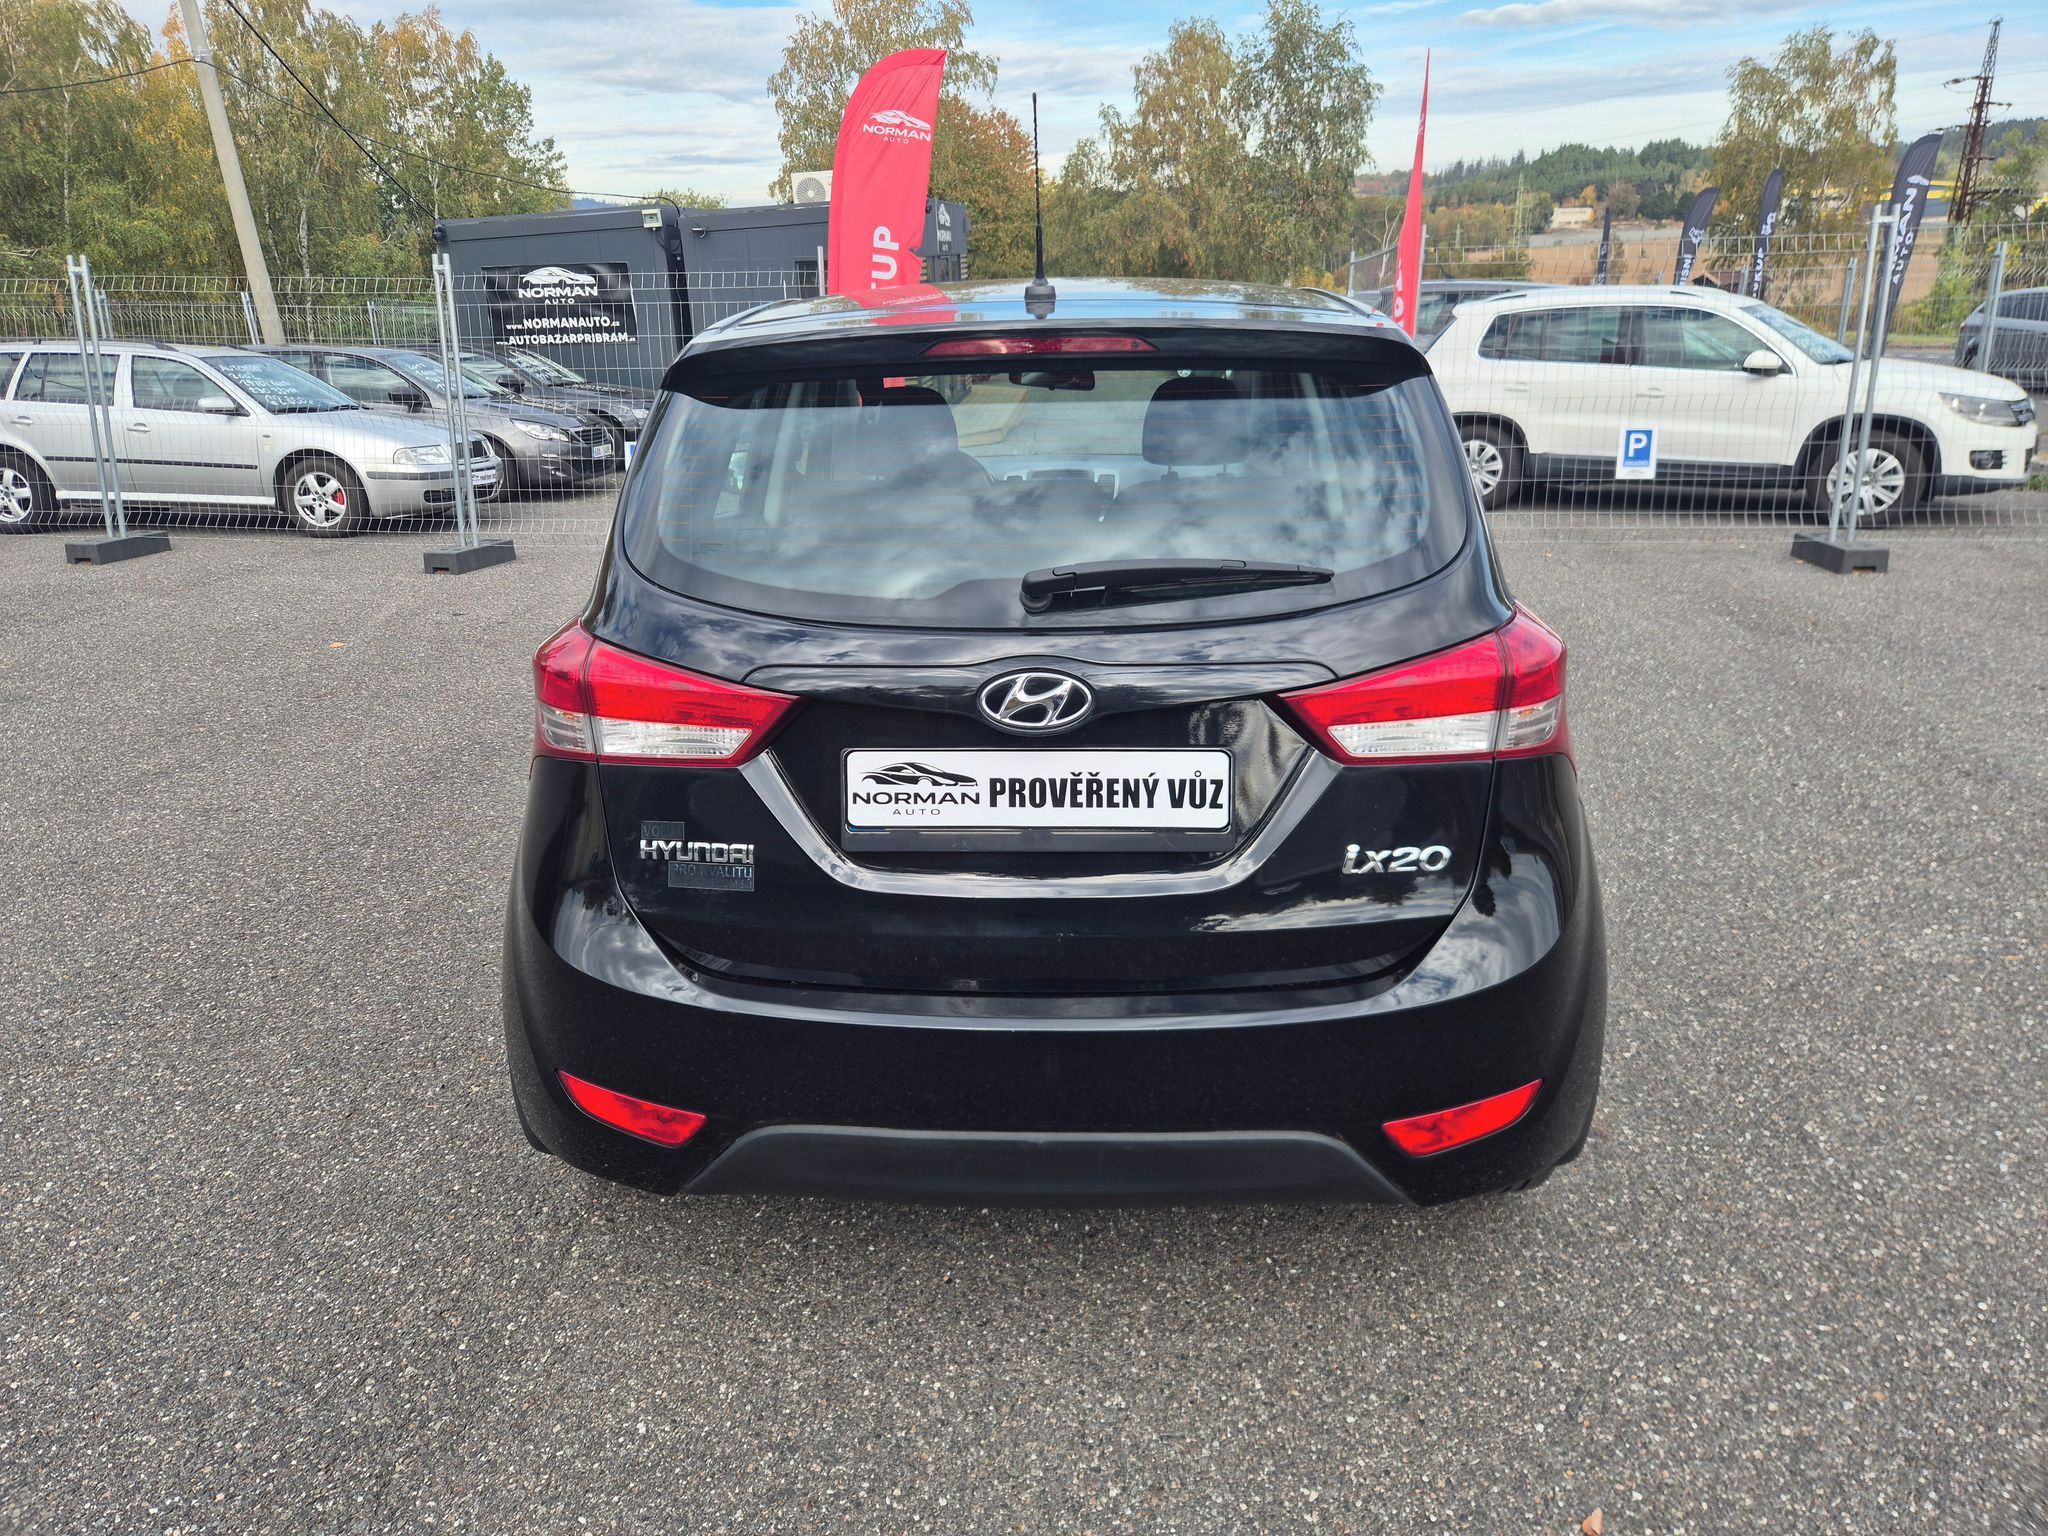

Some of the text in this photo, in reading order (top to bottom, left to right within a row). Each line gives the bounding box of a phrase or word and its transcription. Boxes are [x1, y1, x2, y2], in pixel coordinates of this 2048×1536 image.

[863, 123, 931, 142] NORMAN
[883, 136, 909, 144] AUTO
[870, 226, 899, 290] UP
[518, 286, 598, 298] NORMAN
[1628, 433, 1648, 457] P
[852, 792, 980, 805] NORMAN
[989, 770, 1224, 808] PROVĚŘENÝ VŮZ
[892, 808, 941, 816] AUTO
[640, 840, 754, 864] HYUNDAI
[1341, 843, 1452, 875] ix20
